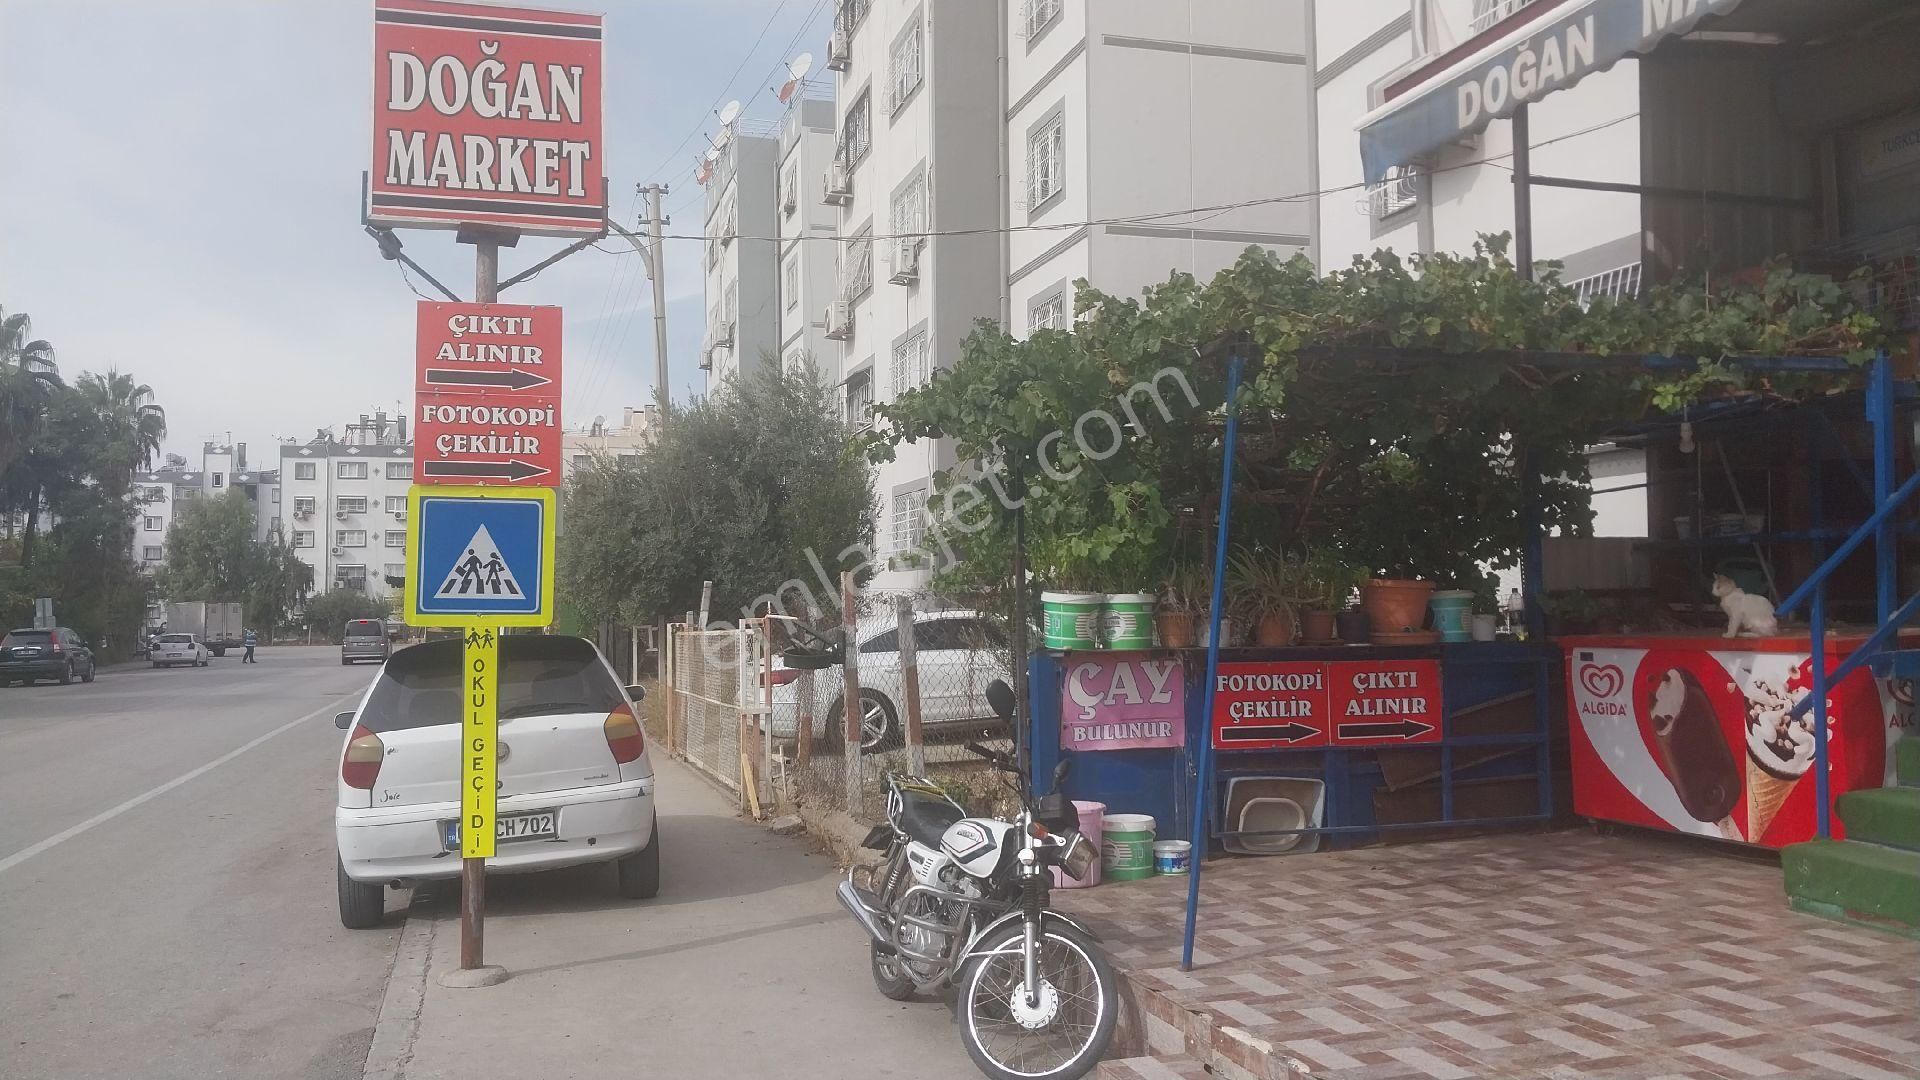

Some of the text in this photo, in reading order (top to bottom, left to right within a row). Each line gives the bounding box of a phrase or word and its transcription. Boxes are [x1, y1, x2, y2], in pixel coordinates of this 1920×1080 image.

[387, 40, 583, 123] DOĞAN
[1457, 14, 1595, 130] DOĞAN
[386, 129, 590, 197] MARKET
[448, 314, 532, 338] ÇIKTI
[436, 342, 543, 364] ALINIR
[422, 404, 555, 427] FOTOKOPİ
[436, 430, 540, 458] ÇEKİLİR
[1069, 661, 1176, 720] ÇAY
[1216, 669, 1324, 692] FOTOKOPİ
[1352, 671, 1418, 694] ÇIKTI
[1229, 696, 1312, 724] ÇEKİLİR
[1345, 697, 1427, 716] ALINIR
[1073, 721, 1172, 741] BULUNUR
[471, 658, 486, 849] OKUL GEÇİDİ
[519, 815, 551, 834] 702
